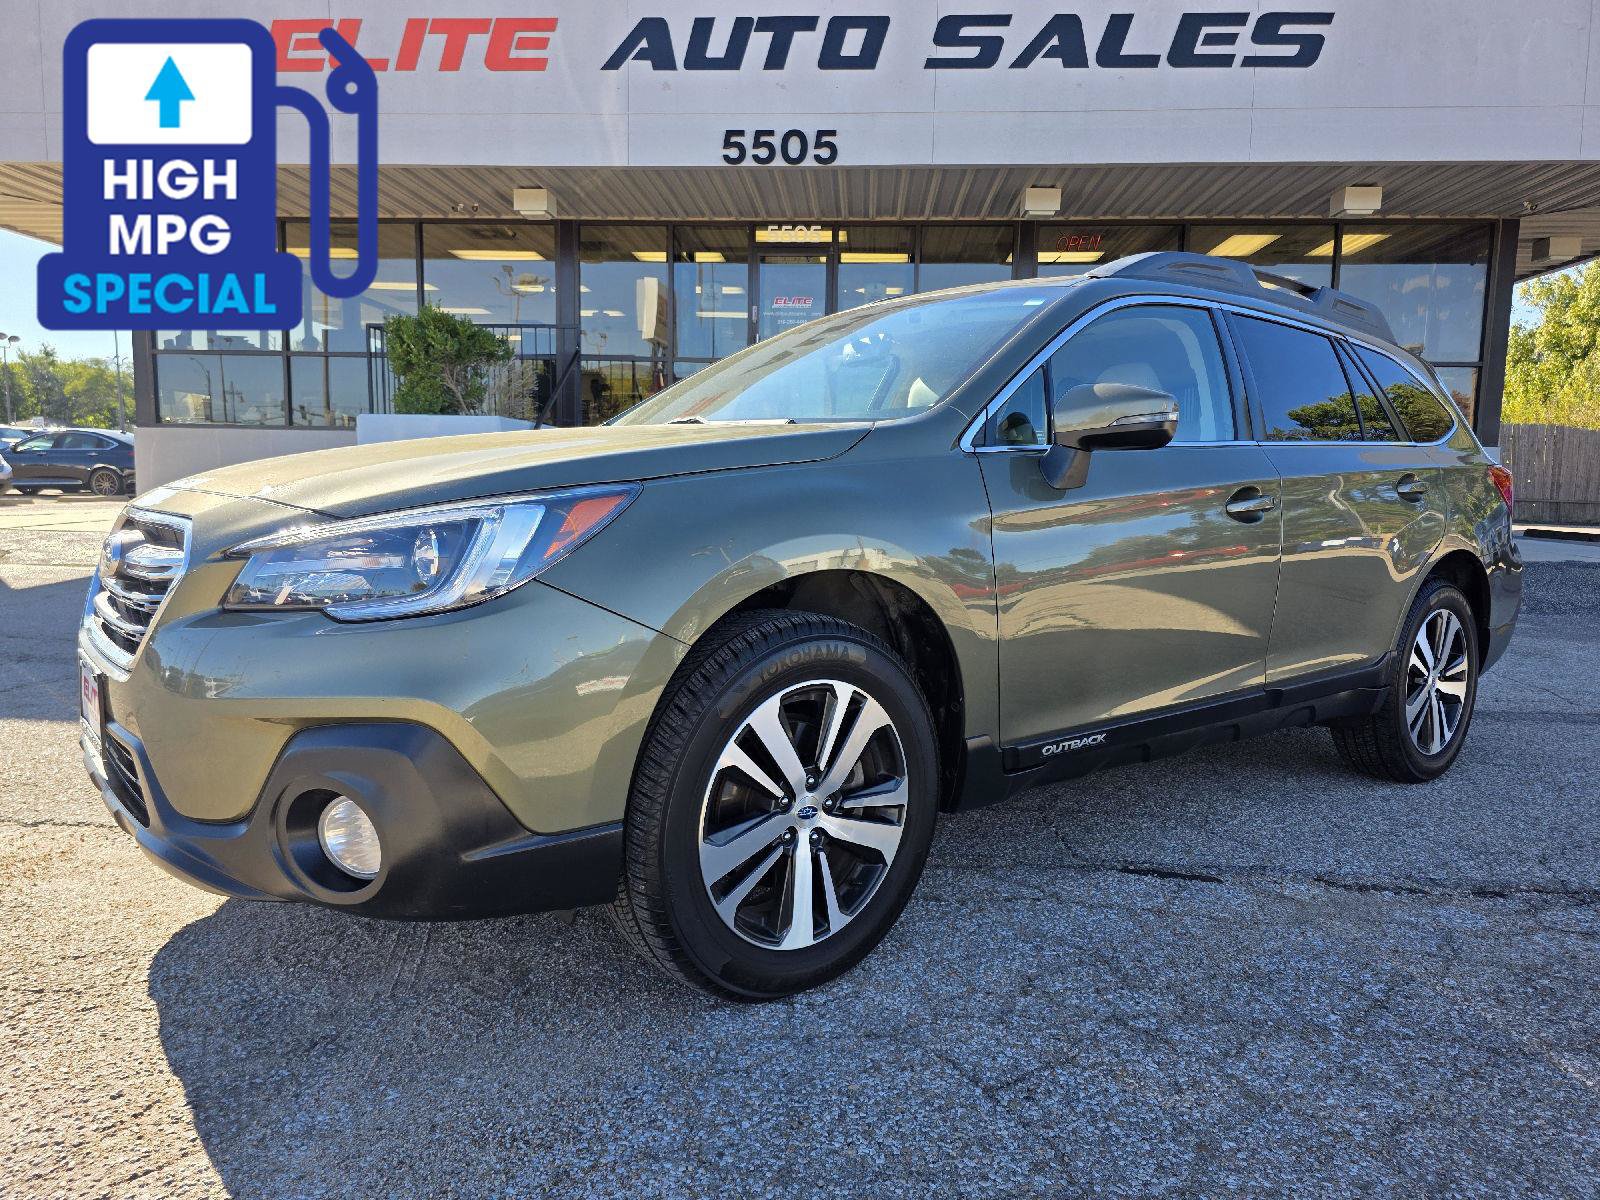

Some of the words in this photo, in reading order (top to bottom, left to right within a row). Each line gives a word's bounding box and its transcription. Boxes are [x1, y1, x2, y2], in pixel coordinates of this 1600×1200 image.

[271, 18, 558, 72] ELITE
[600, 15, 891, 71] AUTO
[924, 12, 1335, 69] SALES
[722, 129, 838, 165] 5505
[767, 225, 822, 243] 5505
[1056, 235, 1103, 252] OPEN
[773, 296, 814, 305] ELITE
[1041, 733, 1107, 756] OUTBACK
